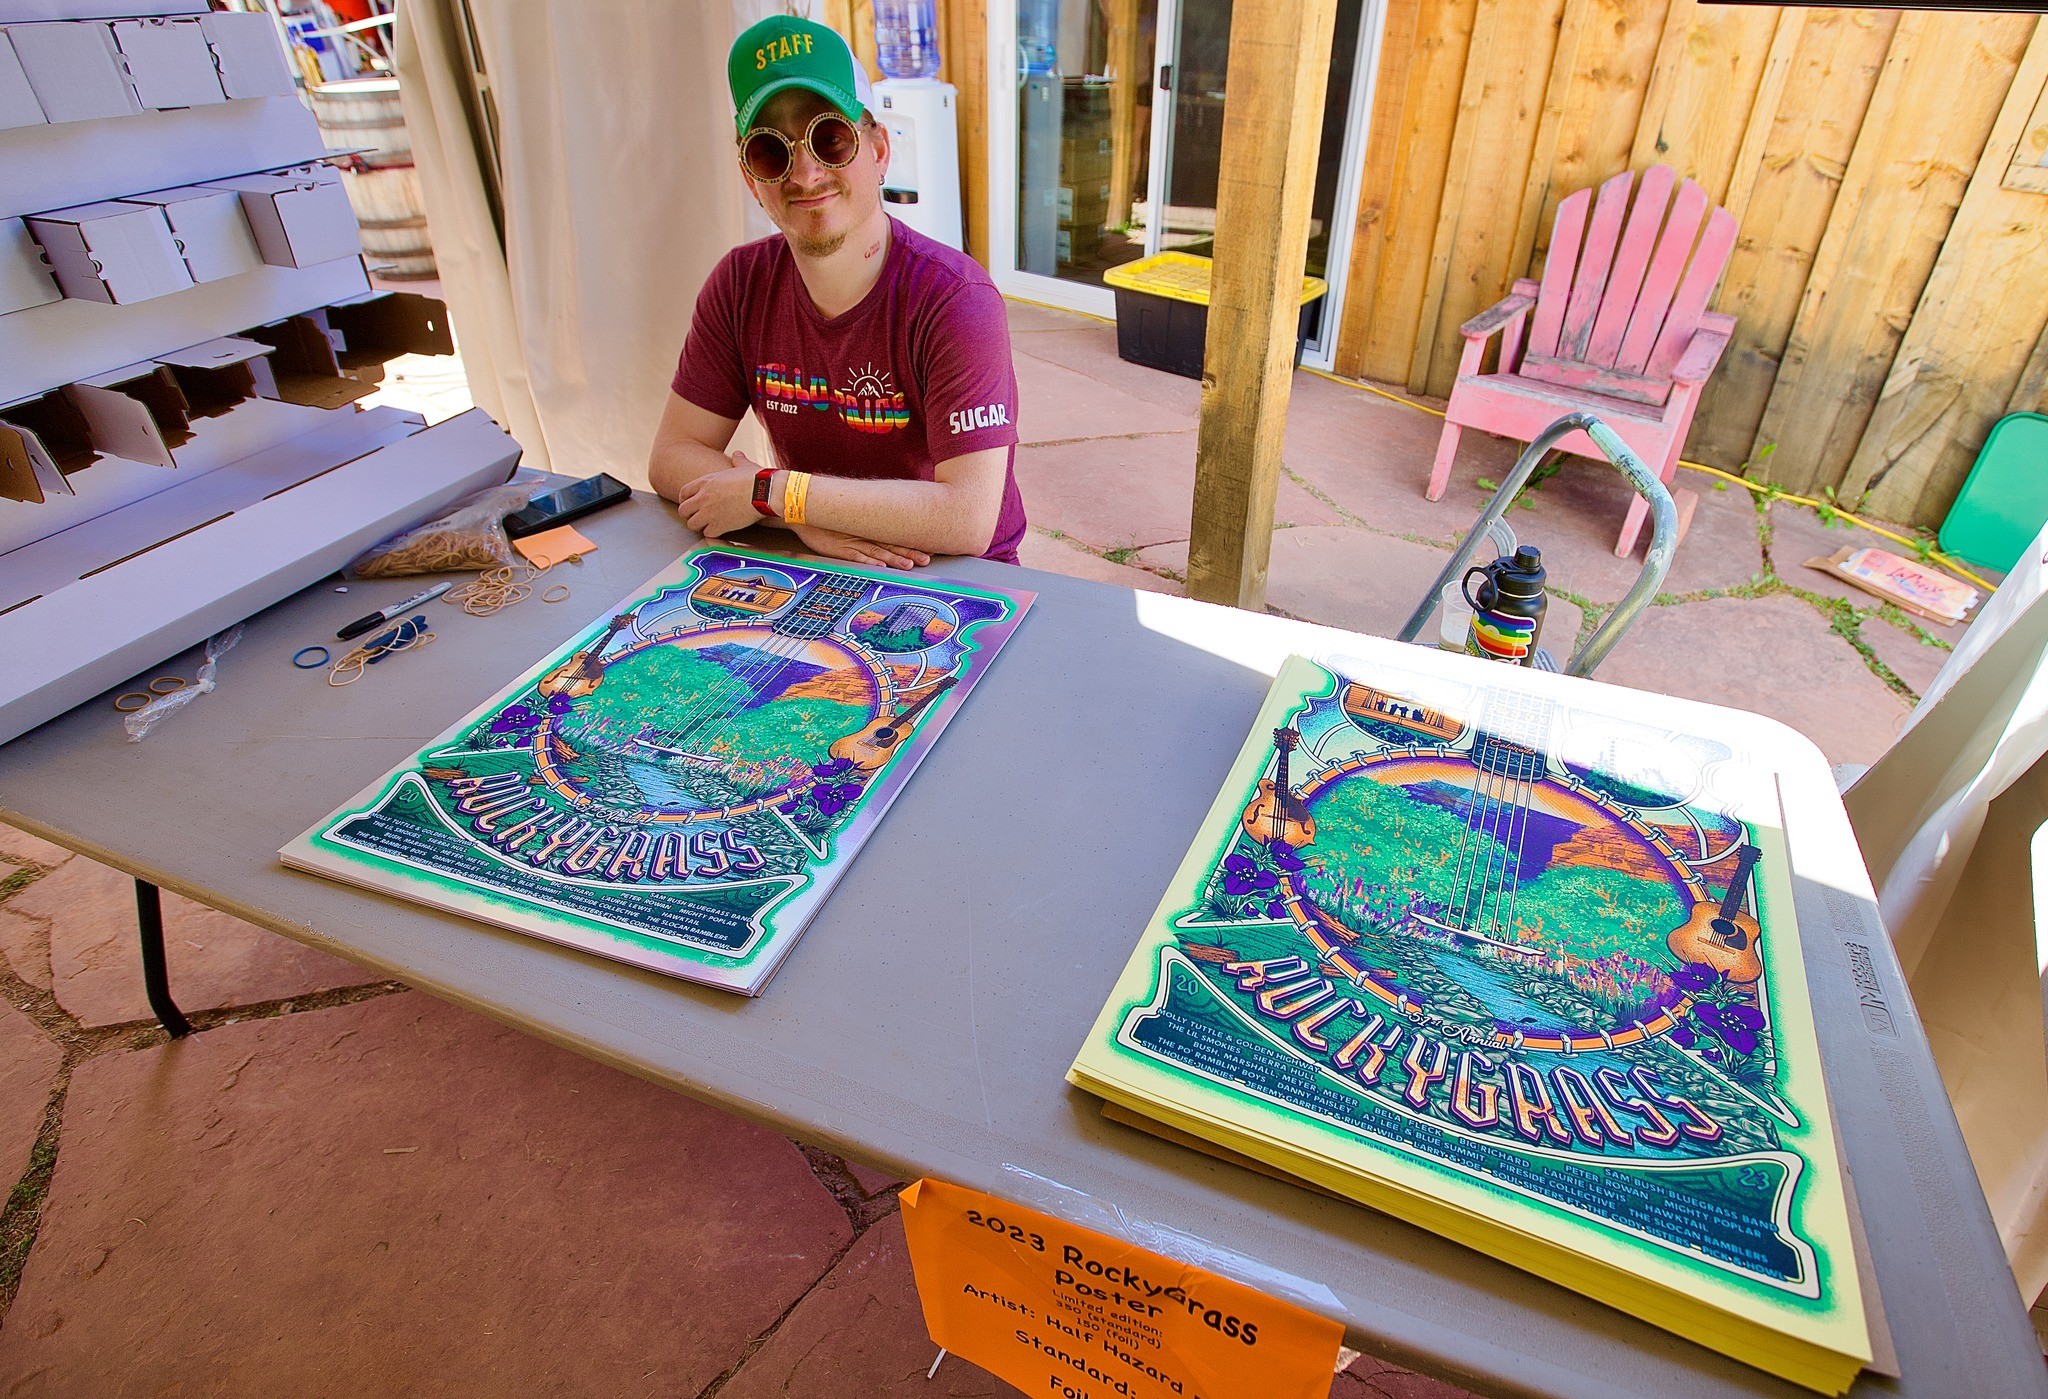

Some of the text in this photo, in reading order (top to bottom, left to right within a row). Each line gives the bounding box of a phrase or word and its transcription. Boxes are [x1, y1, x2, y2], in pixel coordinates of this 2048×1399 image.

[756, 33, 814, 70] STAFF
[766, 400, 798, 415] EST 2022
[950, 403, 1011, 434] SUGAR
[399, 788, 420, 802] 20
[447, 772, 766, 880] ROCKYGRASS
[750, 884, 776, 899] 23
[1177, 974, 1199, 995] 20
[1156, 1008, 1320, 1073] MOLLY TUTTLE & GOLDEN HIGHWAY
[1166, 1021, 1316, 1081] THE LIL SMOKIES SIERRA HULL
[1222, 955, 1726, 1148] ROCKYGRASS
[1442, 1025, 1507, 1050] Annual
[1139, 1039, 1195, 1065] STILLHOUSE
[1195, 1061, 1235, 1081] JUNKIES
[1245, 1080, 1283, 1099] JEREMY
[1285, 1094, 1328, 1115] GARRETT
[1333, 1112, 1341, 1120] &
[1344, 1116, 1373, 1132] RIVER
[1376, 1128, 1403, 1142] WILD
[1413, 1141, 1445, 1158] LARRY
[1448, 1154, 1457, 1162] &
[1460, 1158, 1480, 1171] JOE
[1492, 1169, 1519, 1185] SOUL
[1522, 1180, 1564, 1202] SISTERS
[1588, 1204, 1610, 1218] THE
[1611, 1212, 1640, 1230] CODY
[1645, 1225, 1689, 1248] SISTERS
[1702, 1245, 1729, 1262] PICK
[1732, 1256, 1741, 1266] &
[1747, 1260, 1786, 1282] HOWL
[1156, 1036, 1175, 1048] THE
[1241, 1068, 1266, 1082] BOYS
[1276, 1081, 1311, 1099] DANNY
[1313, 1095, 1351, 1114] PAISLEY
[1362, 1112, 1375, 1122] AJ
[1380, 1119, 1399, 1131] LEE
[1404, 1127, 1412, 1136] &
[1415, 1131, 1441, 1146] BLUE
[1443, 1142, 1485, 1162] SUMMIT
[1499, 1162, 1545, 1184] FIRESIDE
[1549, 1179, 1615, 1210] COLLECTIVE
[1629, 1208, 1650, 1222] THE
[1654, 1216, 1700, 1240] SLOCAN
[1704, 1233, 1768, 1264] RAMBLERS
[1322, 1088, 1359, 1106] MEYER
[1374, 1106, 1401, 1122] BELA
[1408, 1119, 1442, 1137] FLECK
[1458, 1137, 1477, 1149] BIG
[1480, 1144, 1529, 1168] RICHARD
[1543, 1167, 1584, 1188] LAURIE
[1589, 1183, 1625, 1203] LEWIS
[1645, 1202, 1708, 1232] HAWKTAIL
[1565, 1164, 1761, 1239] PETER ROWAN MIGHTY POPLAR
[1604, 1167, 1778, 1234] SAM BUSH BLUEGRASS BAND
[1738, 1167, 1770, 1191] 23
[967, 1210, 1259, 1346] 2023 RockyGrass
[1055, 1270, 1163, 1318] Poster
[1053, 1289, 1163, 1338] Limited edition:
[1055, 1301, 1162, 1350] 350 (standard)
[1076, 1318, 1140, 1350] 150 (foil)
[964, 1283, 1183, 1395] Artist: Half Hazard
